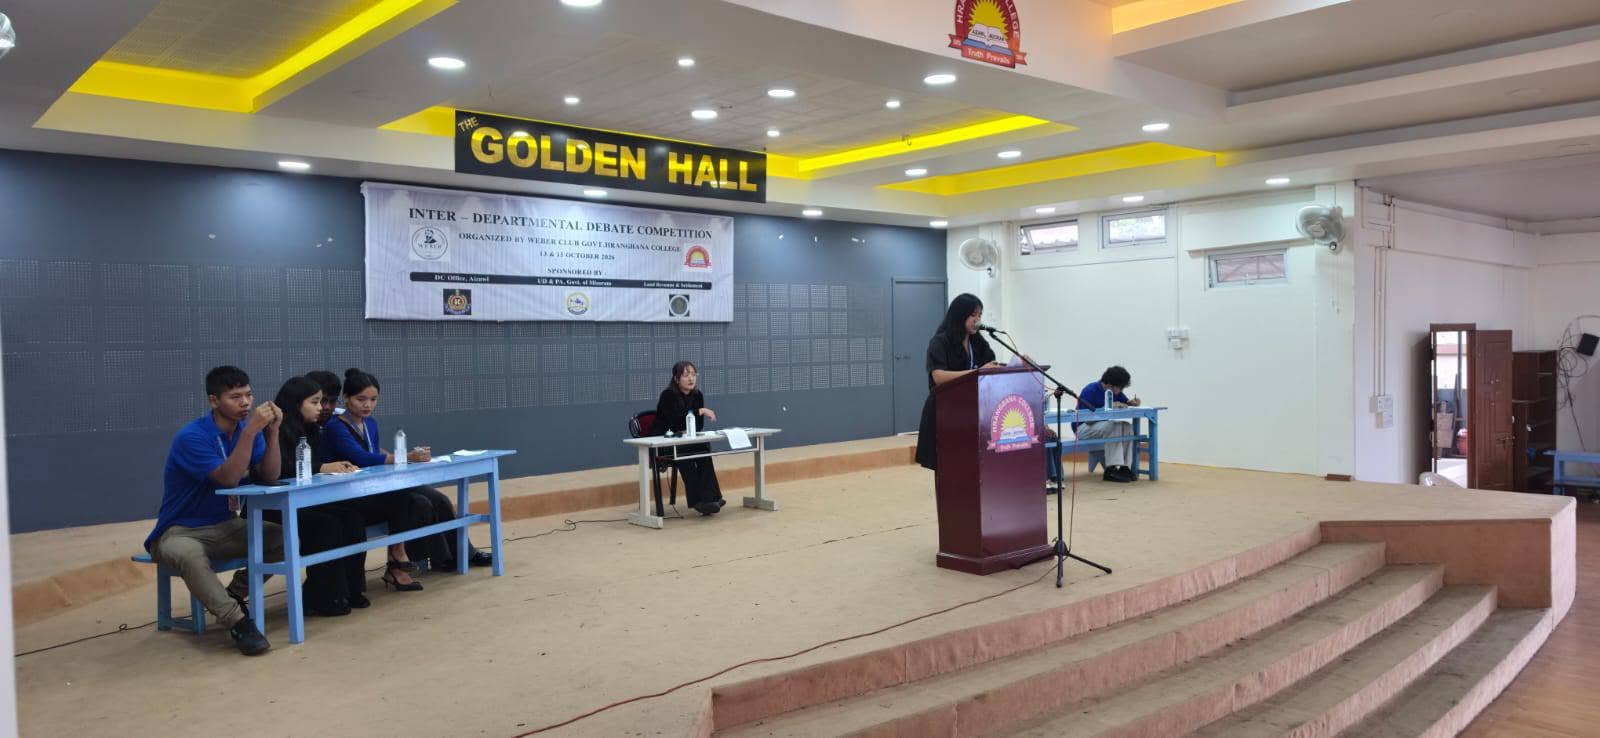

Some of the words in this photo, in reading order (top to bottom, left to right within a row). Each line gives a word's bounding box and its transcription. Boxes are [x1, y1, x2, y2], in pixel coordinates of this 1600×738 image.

[458, 116, 479, 132] THE
[470, 126, 646, 181] GOLDEN
[668, 151, 757, 192] HALL
[409, 207, 456, 222] INTER
[473, 212, 582, 231] DEPARTMENTAL
[586, 221, 634, 235] DEBATE
[637, 225, 713, 240] COMPETITION
[459, 233, 512, 242] ORGANIZED
[527, 237, 556, 246] WEBER
[558, 239, 580, 247] CLUB
[565, 252, 599, 260] OCTOBER
[547, 267, 592, 276] SPONSORED
